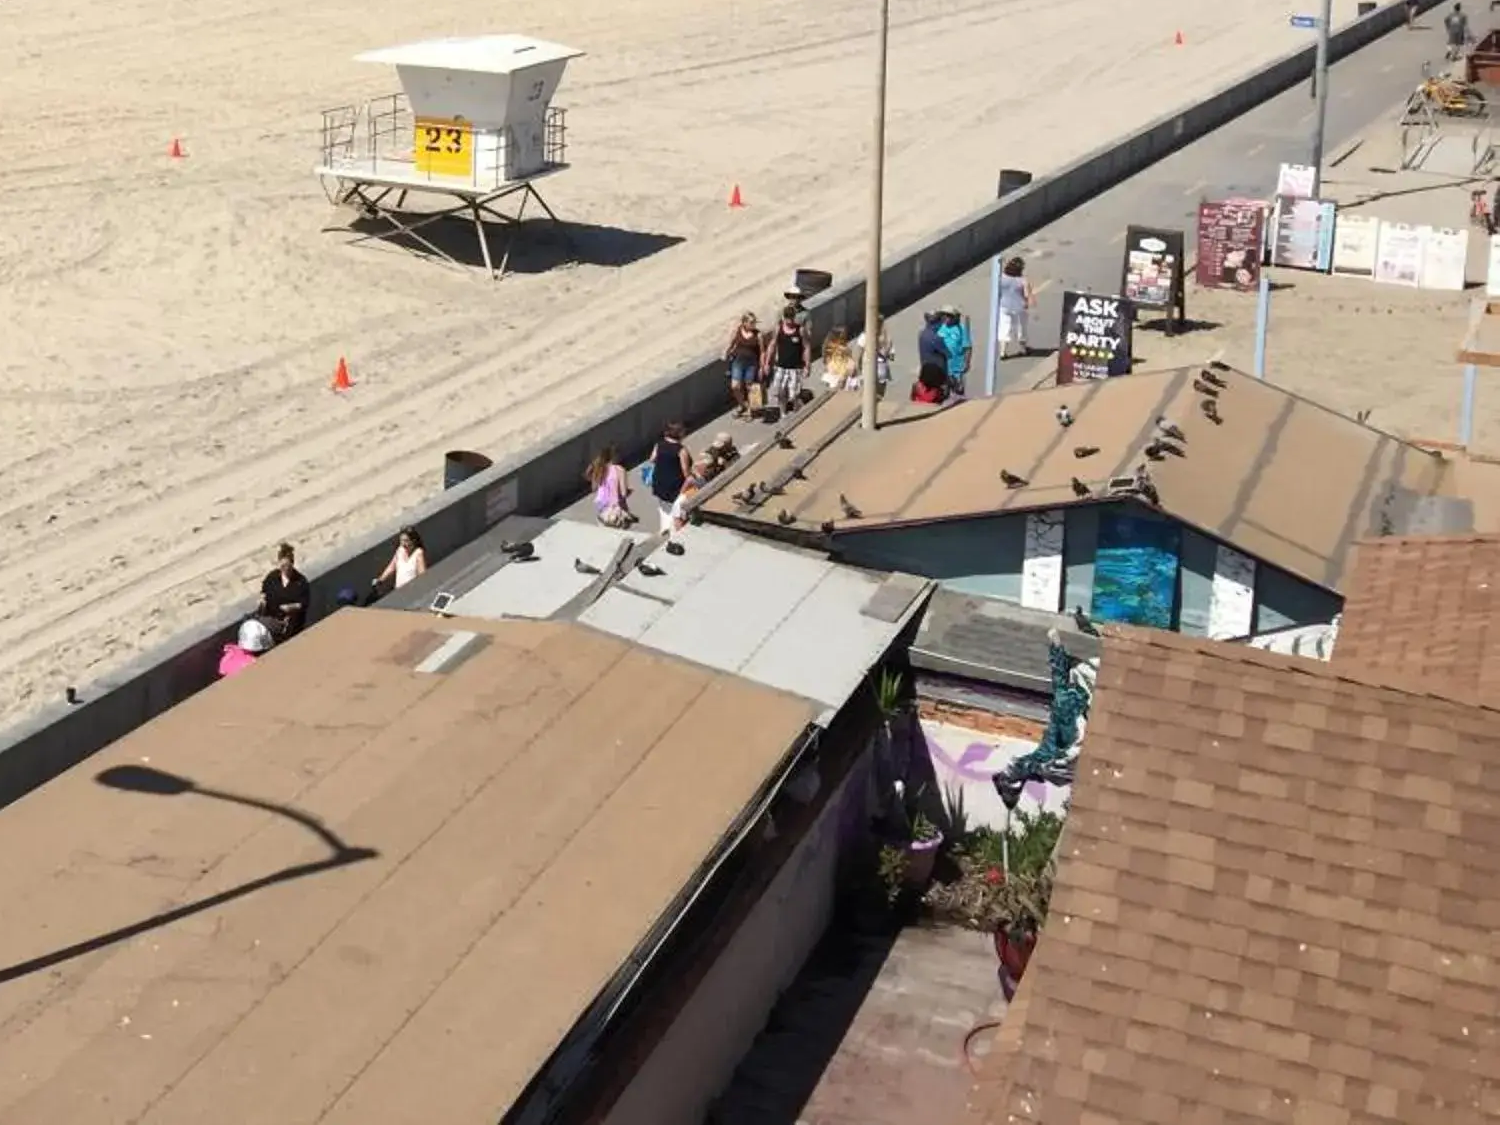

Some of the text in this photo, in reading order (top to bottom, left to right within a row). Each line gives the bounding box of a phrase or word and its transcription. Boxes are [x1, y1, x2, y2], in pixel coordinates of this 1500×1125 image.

[425, 127, 462, 153] 23
[1073, 297, 1119, 317] ASK
[1076, 315, 1115, 328] ABOUT
[1084, 325, 1105, 335] THE
[1066, 331, 1120, 350] PARTY
